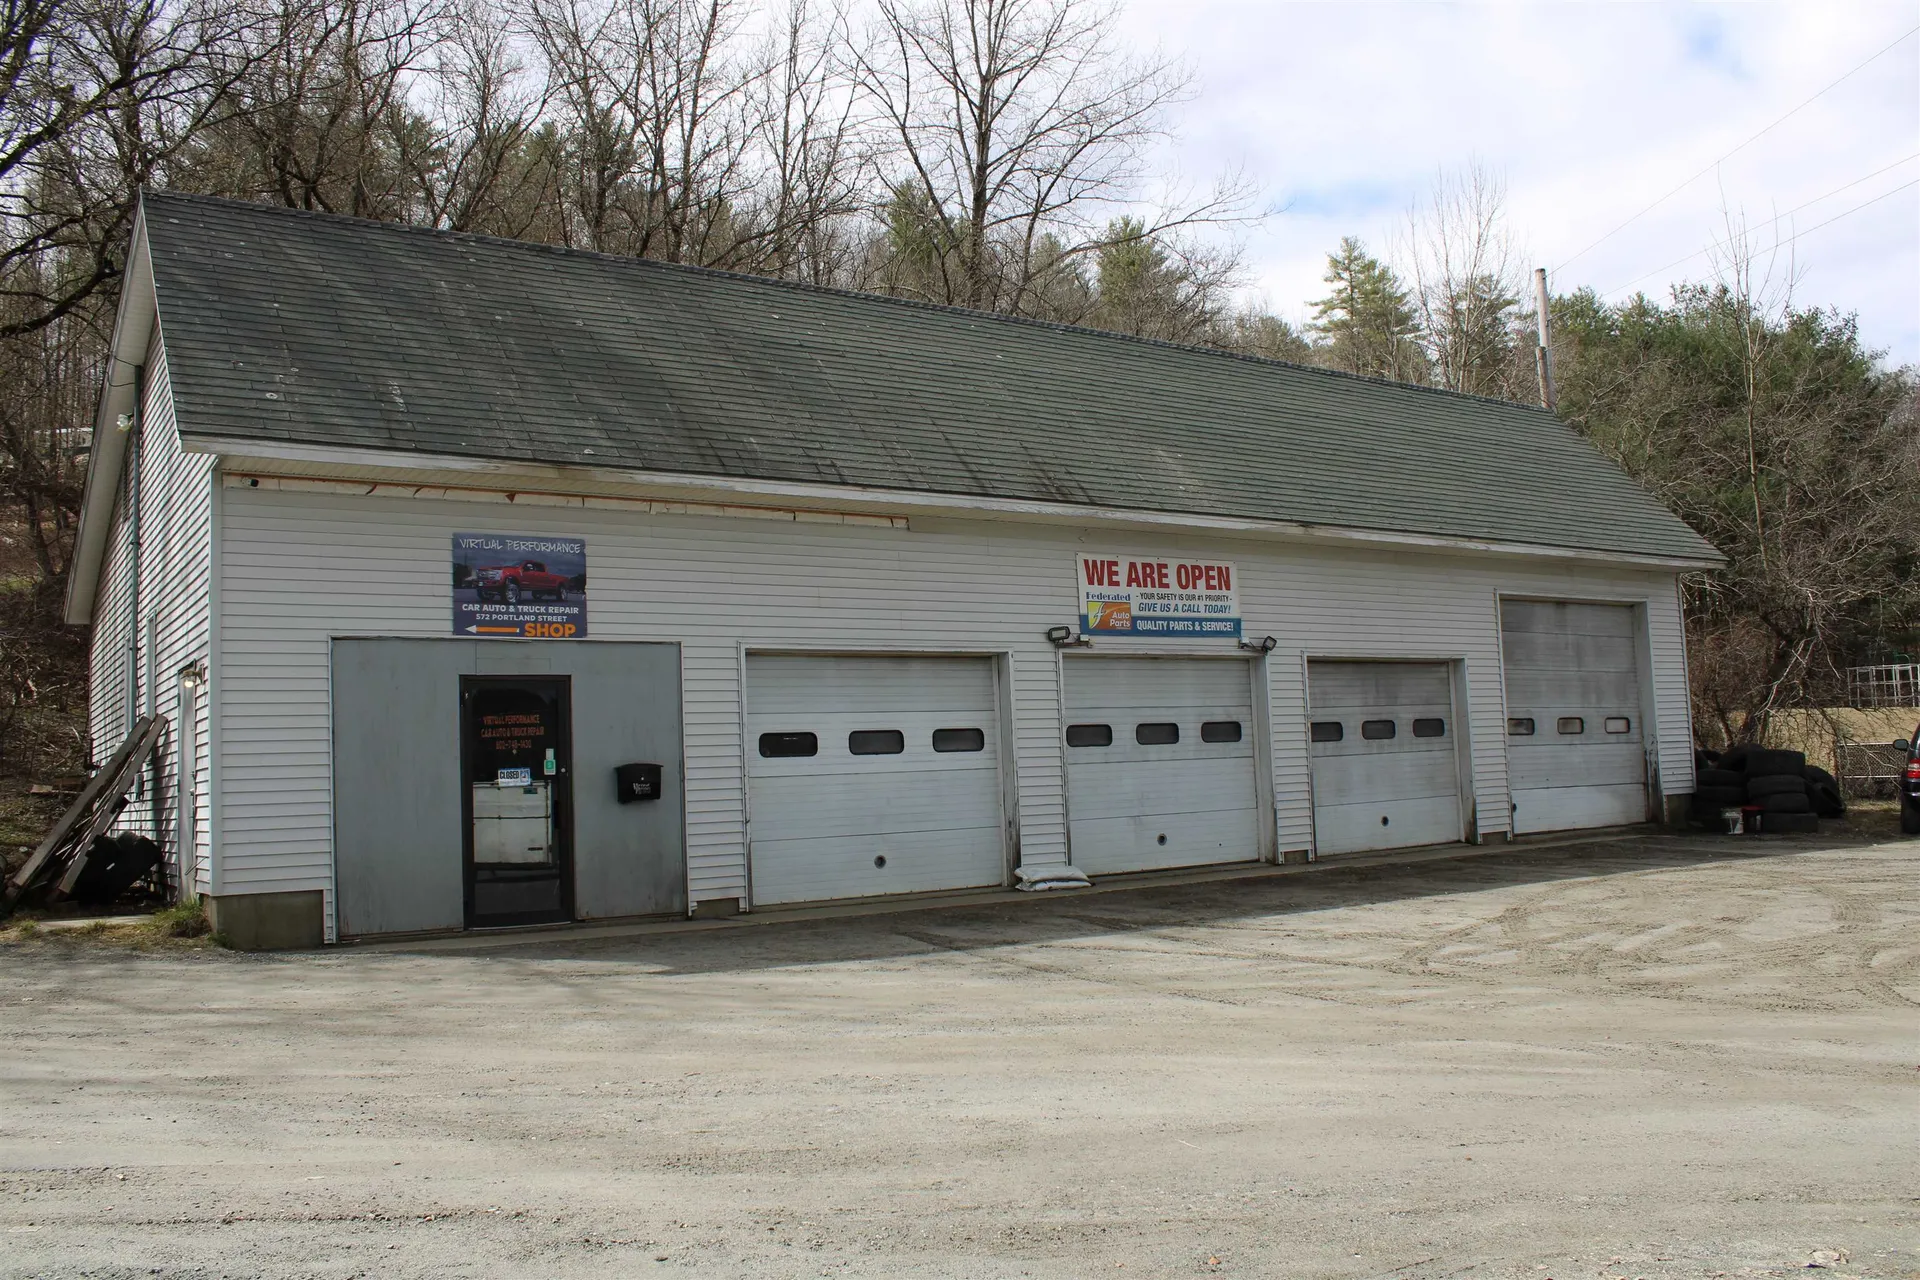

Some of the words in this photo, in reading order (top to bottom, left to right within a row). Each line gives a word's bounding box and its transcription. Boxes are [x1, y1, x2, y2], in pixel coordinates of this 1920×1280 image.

[460, 539, 502, 549] VIRTUAL
[506, 540, 580, 554] PERFORMANCE
[1083, 559, 1120, 586] WE
[1126, 562, 1170, 588] ARE
[1176, 564, 1231, 590] OPEN
[1086, 592, 1130, 601] Federated
[1138, 602, 1158, 612] GIVE
[1160, 603, 1170, 612] US
[1173, 604, 1179, 612] A
[1181, 604, 1201, 613] CALL
[1203, 604, 1231, 614] TODAY!
[1110, 619, 1131, 627] Parts
[1137, 620, 1167, 630] QUALITY
[1170, 621, 1193, 630] PARTS
[1194, 622, 1200, 630] &
[1202, 622, 1234, 631] SERVICE!
[524, 623, 576, 638] SHOP
[483, 716, 504, 725] VIRTUAL
[505, 715, 540, 724] PERFORMANCE
[511, 727, 527, 736] TRUCK
[500, 771, 519, 779] CLOSED
